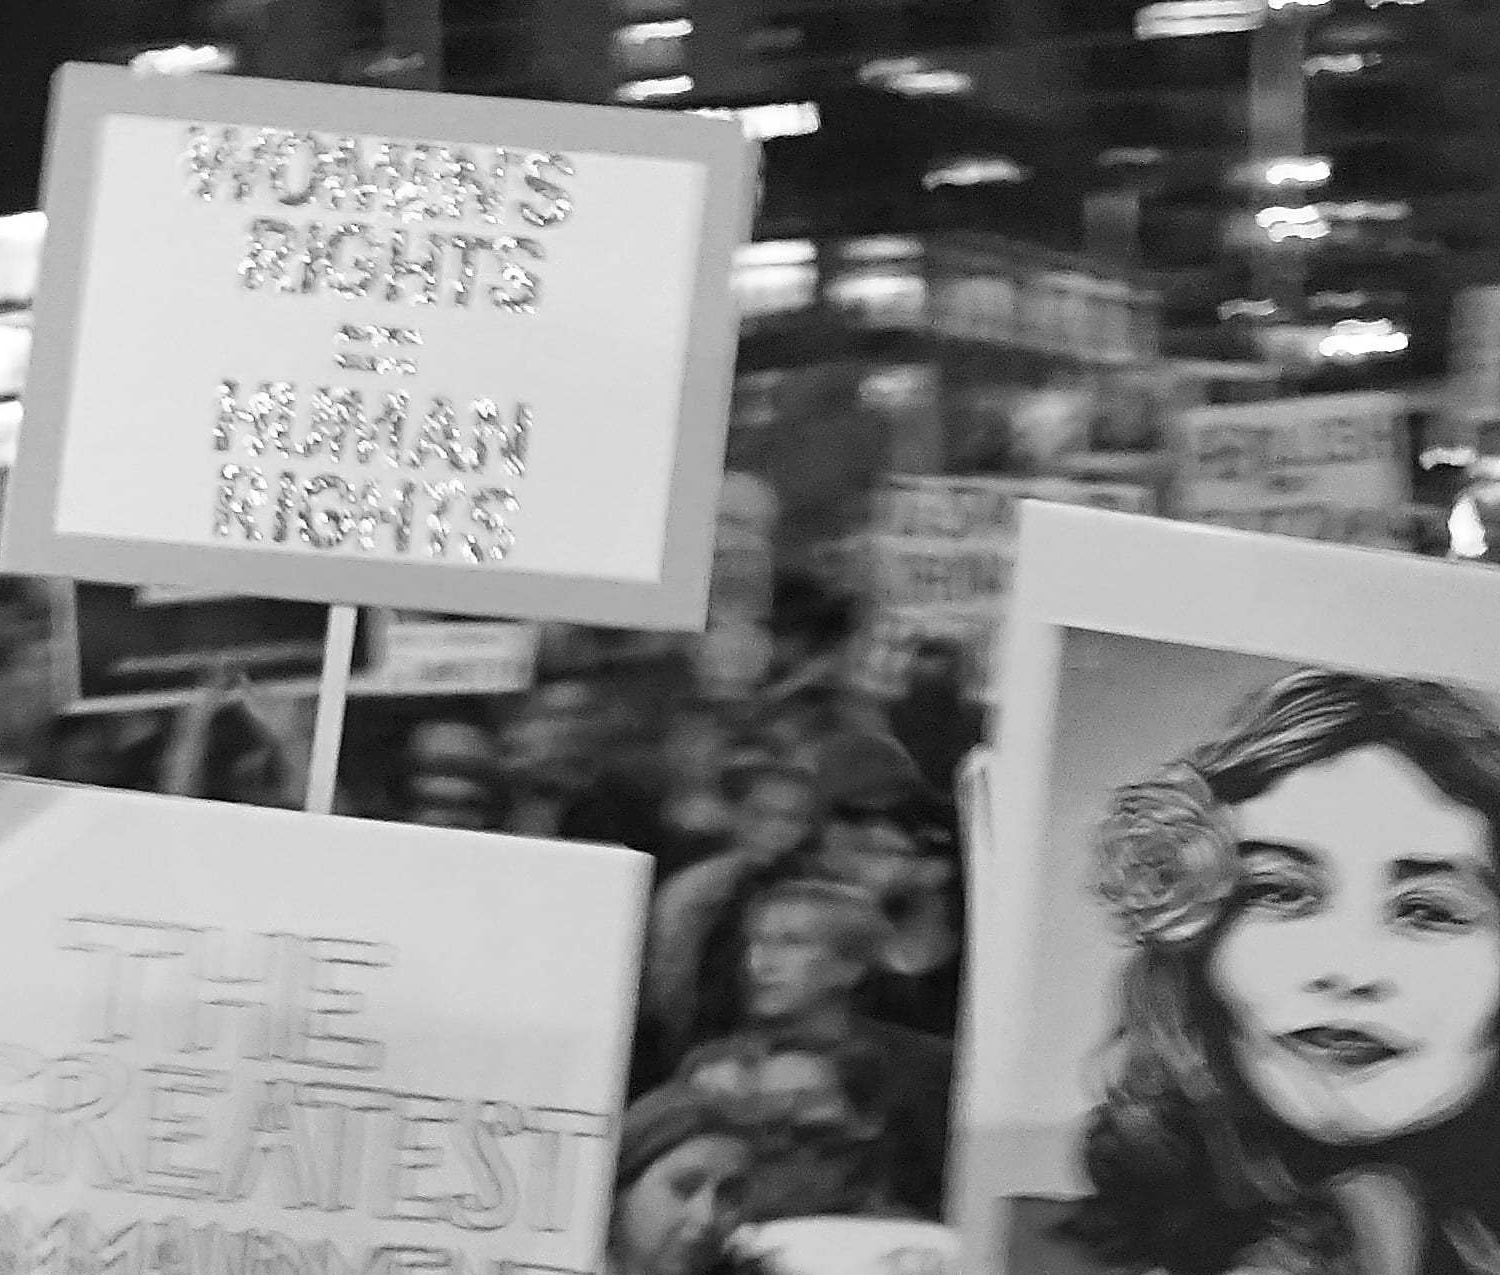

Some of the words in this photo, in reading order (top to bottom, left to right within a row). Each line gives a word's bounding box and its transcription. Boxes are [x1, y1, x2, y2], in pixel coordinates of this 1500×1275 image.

[237, 216, 546, 313] RIGHTS
[213, 380, 533, 478] HUMAN
[213, 463, 523, 565] RIGHTS
[56, 914, 401, 1074] THE
